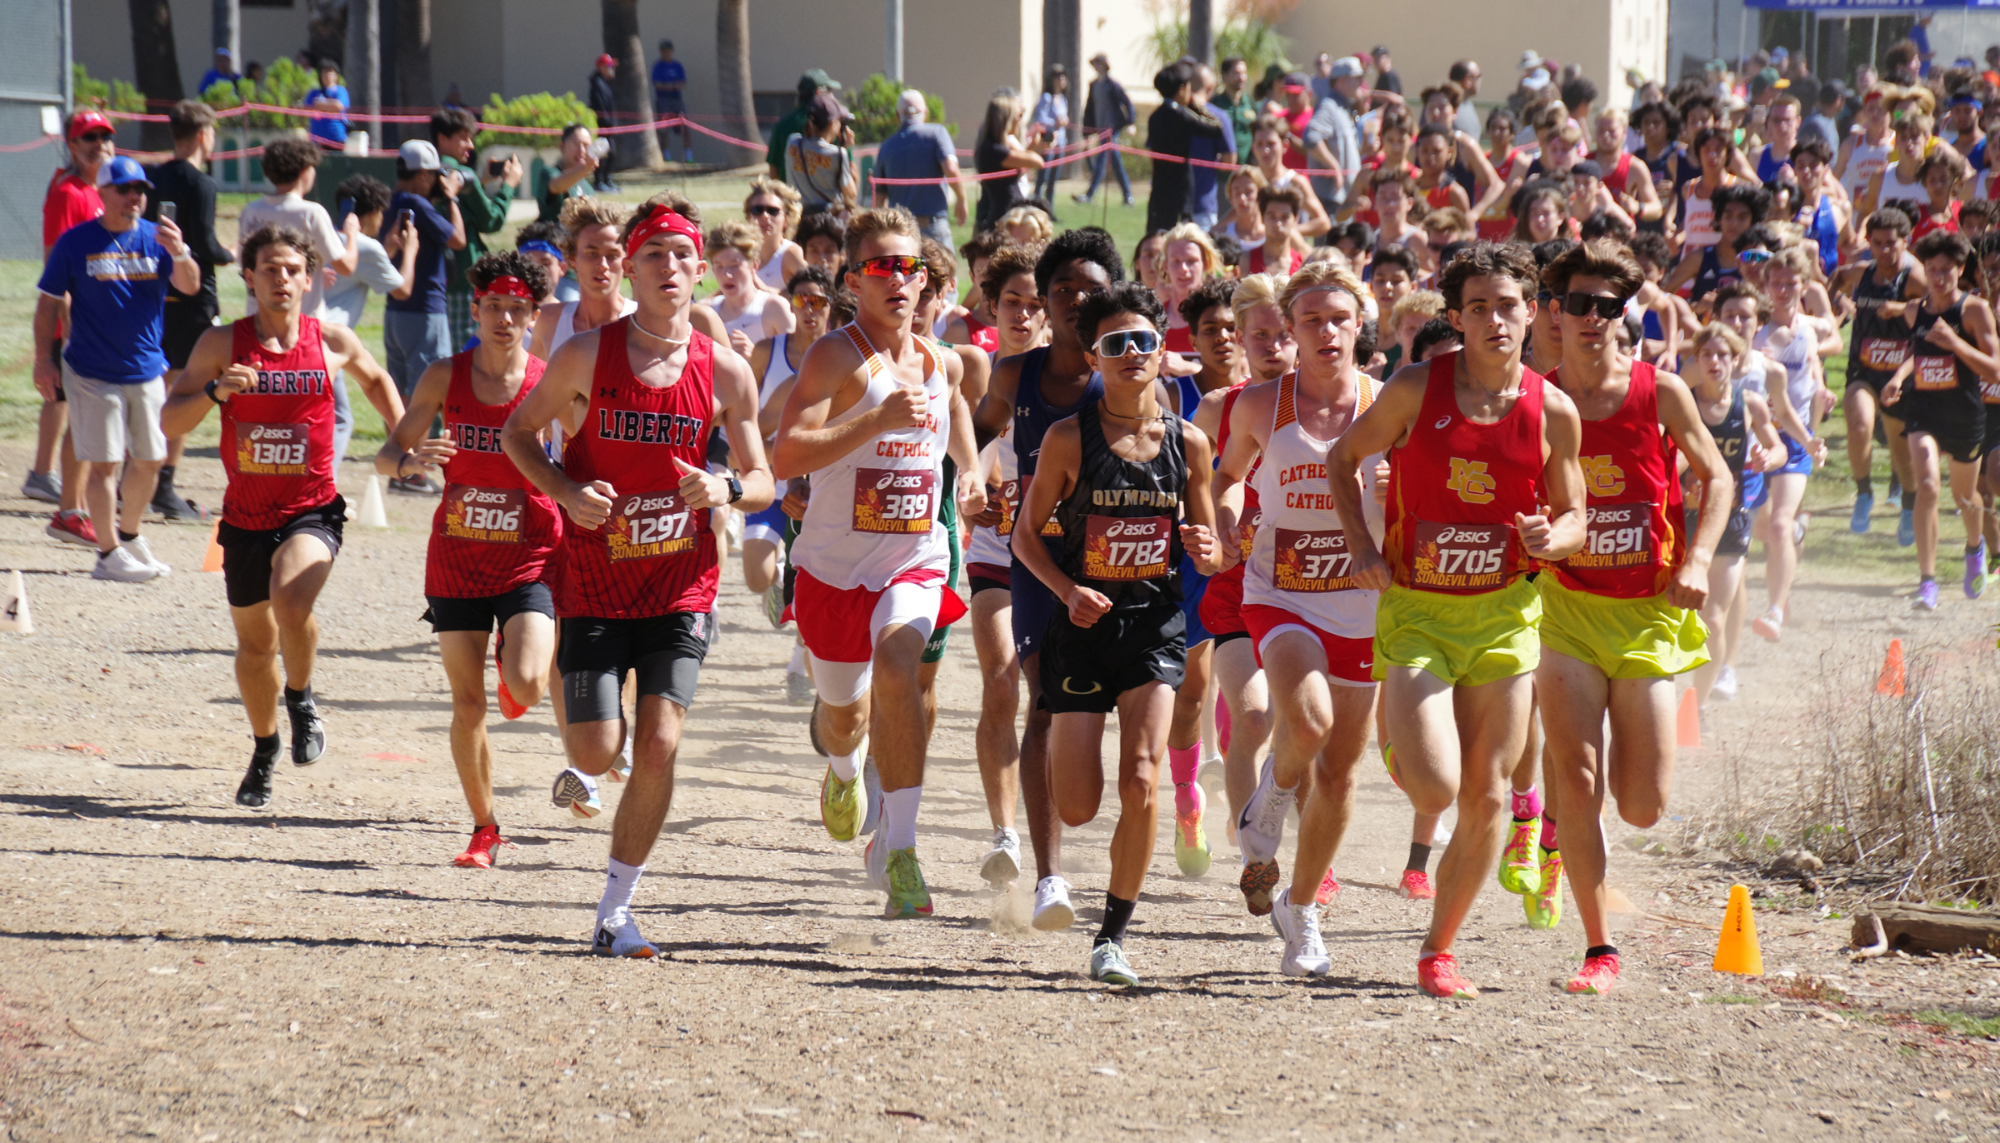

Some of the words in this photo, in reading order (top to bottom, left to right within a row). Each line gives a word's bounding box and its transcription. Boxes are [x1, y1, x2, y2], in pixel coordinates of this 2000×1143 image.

[240, 370, 326, 395] BERTY
[1923, 367, 1954, 382] 1522
[263, 428, 293, 439] asics
[598, 408, 703, 448] LIBERTY
[253, 443, 305, 464] 1303
[892, 475, 922, 487] asics
[476, 492, 507, 503] asics
[641, 496, 674, 511] asics
[1093, 489, 1178, 508] OLYMPIAN
[882, 494, 929, 519] 389
[465, 506, 519, 530] 1306
[856, 518, 905, 531] SUNDEVIL
[907, 519, 931, 531] INVITE
[1596, 510, 1631, 523] asics
[446, 525, 488, 540] SUNDEVIL
[489, 531, 519, 542] INVITE
[629, 512, 689, 544] 1297
[1123, 523, 1156, 535] asics
[1310, 536, 1345, 548] asics
[1454, 532, 1491, 543] asics
[1588, 527, 1643, 555] 1691
[611, 543, 661, 559] SUNDEVIL
[662, 537, 694, 553] INVITE
[1108, 539, 1167, 566] 1782
[1302, 553, 1351, 578] 377
[1438, 548, 1504, 574] 1705
[1568, 554, 1613, 567] SUNDEVIL
[1616, 551, 1649, 565] INVITE
[1086, 562, 1135, 578] SUNDEVIL
[1137, 563, 1166, 577] INVITE
[1277, 577, 1326, 591] SUNDEVIL
[1415, 572, 1466, 586] SUNDEVIL
[1469, 572, 1502, 586] INVITE
